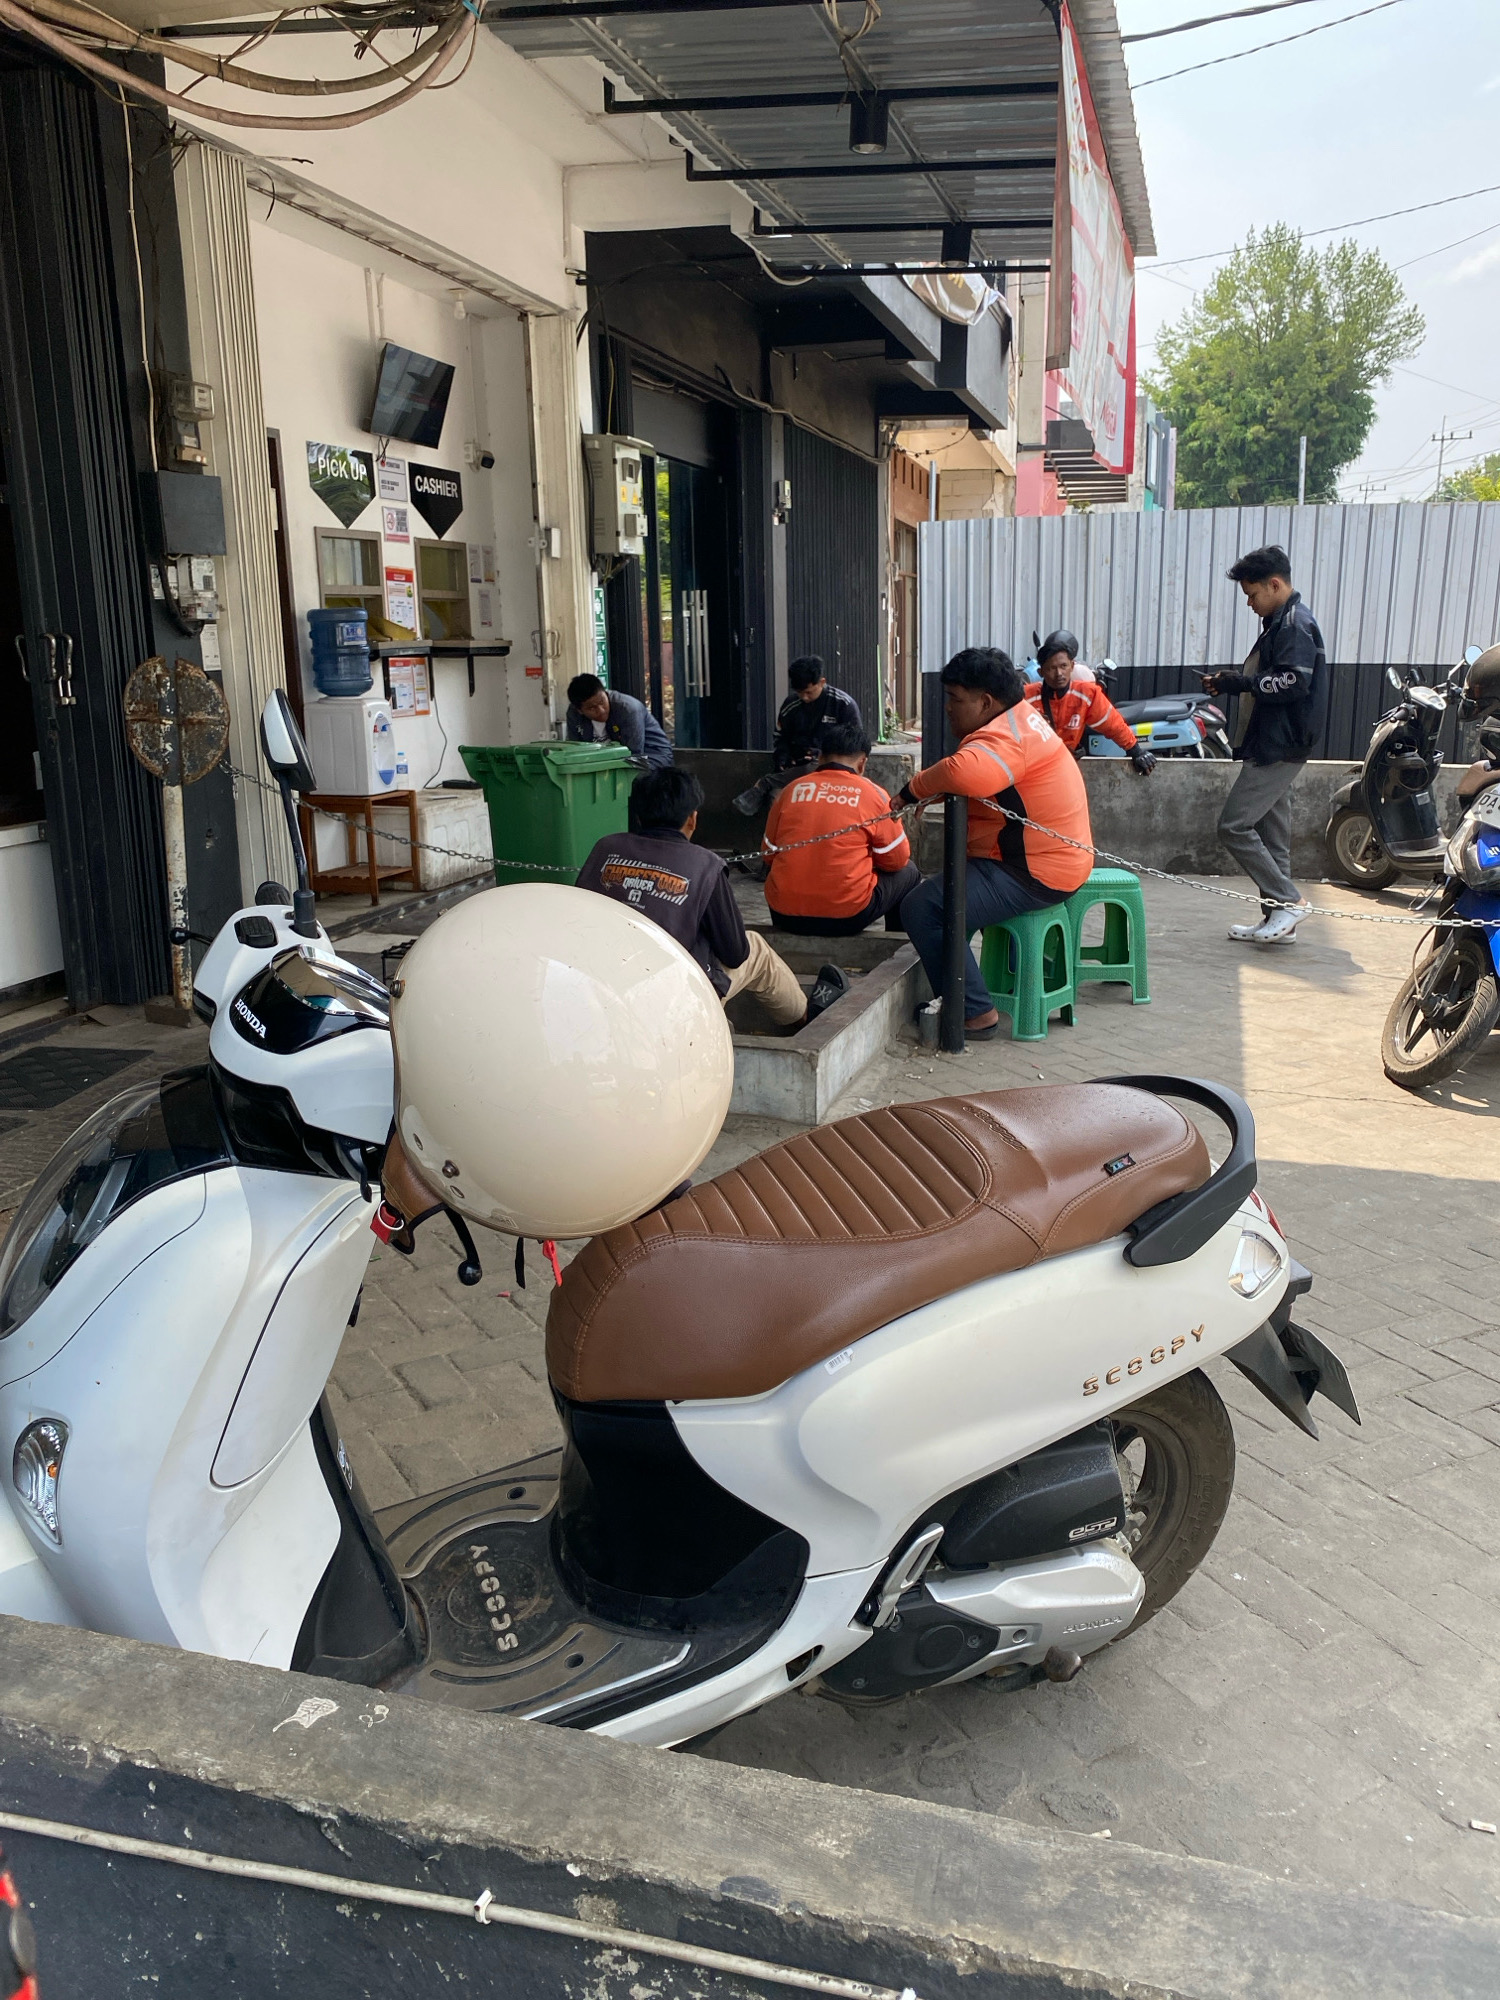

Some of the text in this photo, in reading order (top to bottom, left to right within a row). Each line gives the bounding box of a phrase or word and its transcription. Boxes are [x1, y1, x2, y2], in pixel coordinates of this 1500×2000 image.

[318, 456, 367, 481] PICK UP
[415, 475, 459, 498] CASHIER
[815, 790, 860, 808] Food
[819, 782, 862, 794] Shopee
[235, 998, 267, 1039] HONDA
[1082, 1323, 1206, 1397] SCOOPY
[469, 1544, 519, 1653] SCOOPY
[1062, 1615, 1123, 1634] HONDA
